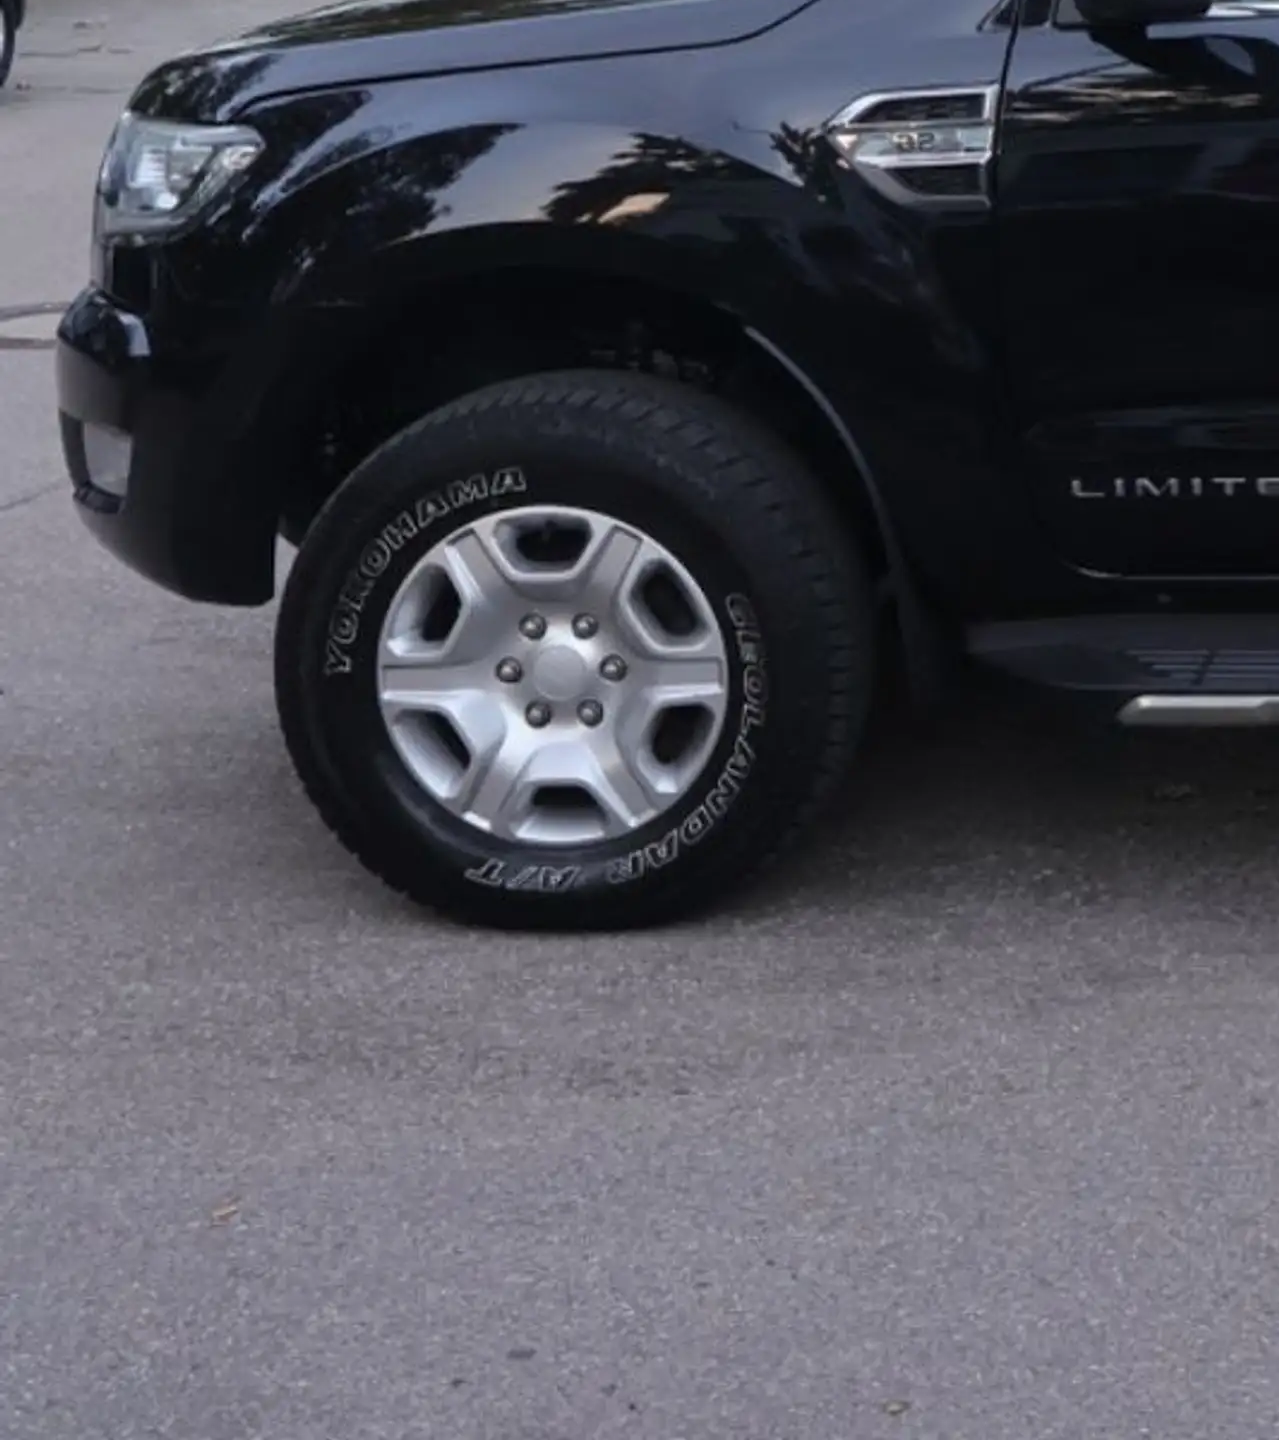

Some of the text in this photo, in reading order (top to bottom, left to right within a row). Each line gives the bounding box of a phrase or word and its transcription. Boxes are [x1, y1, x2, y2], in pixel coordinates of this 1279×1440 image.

[322, 465, 527, 676] YOKOHAMA
[465, 591, 770, 892] GEOLANDAR A/T
